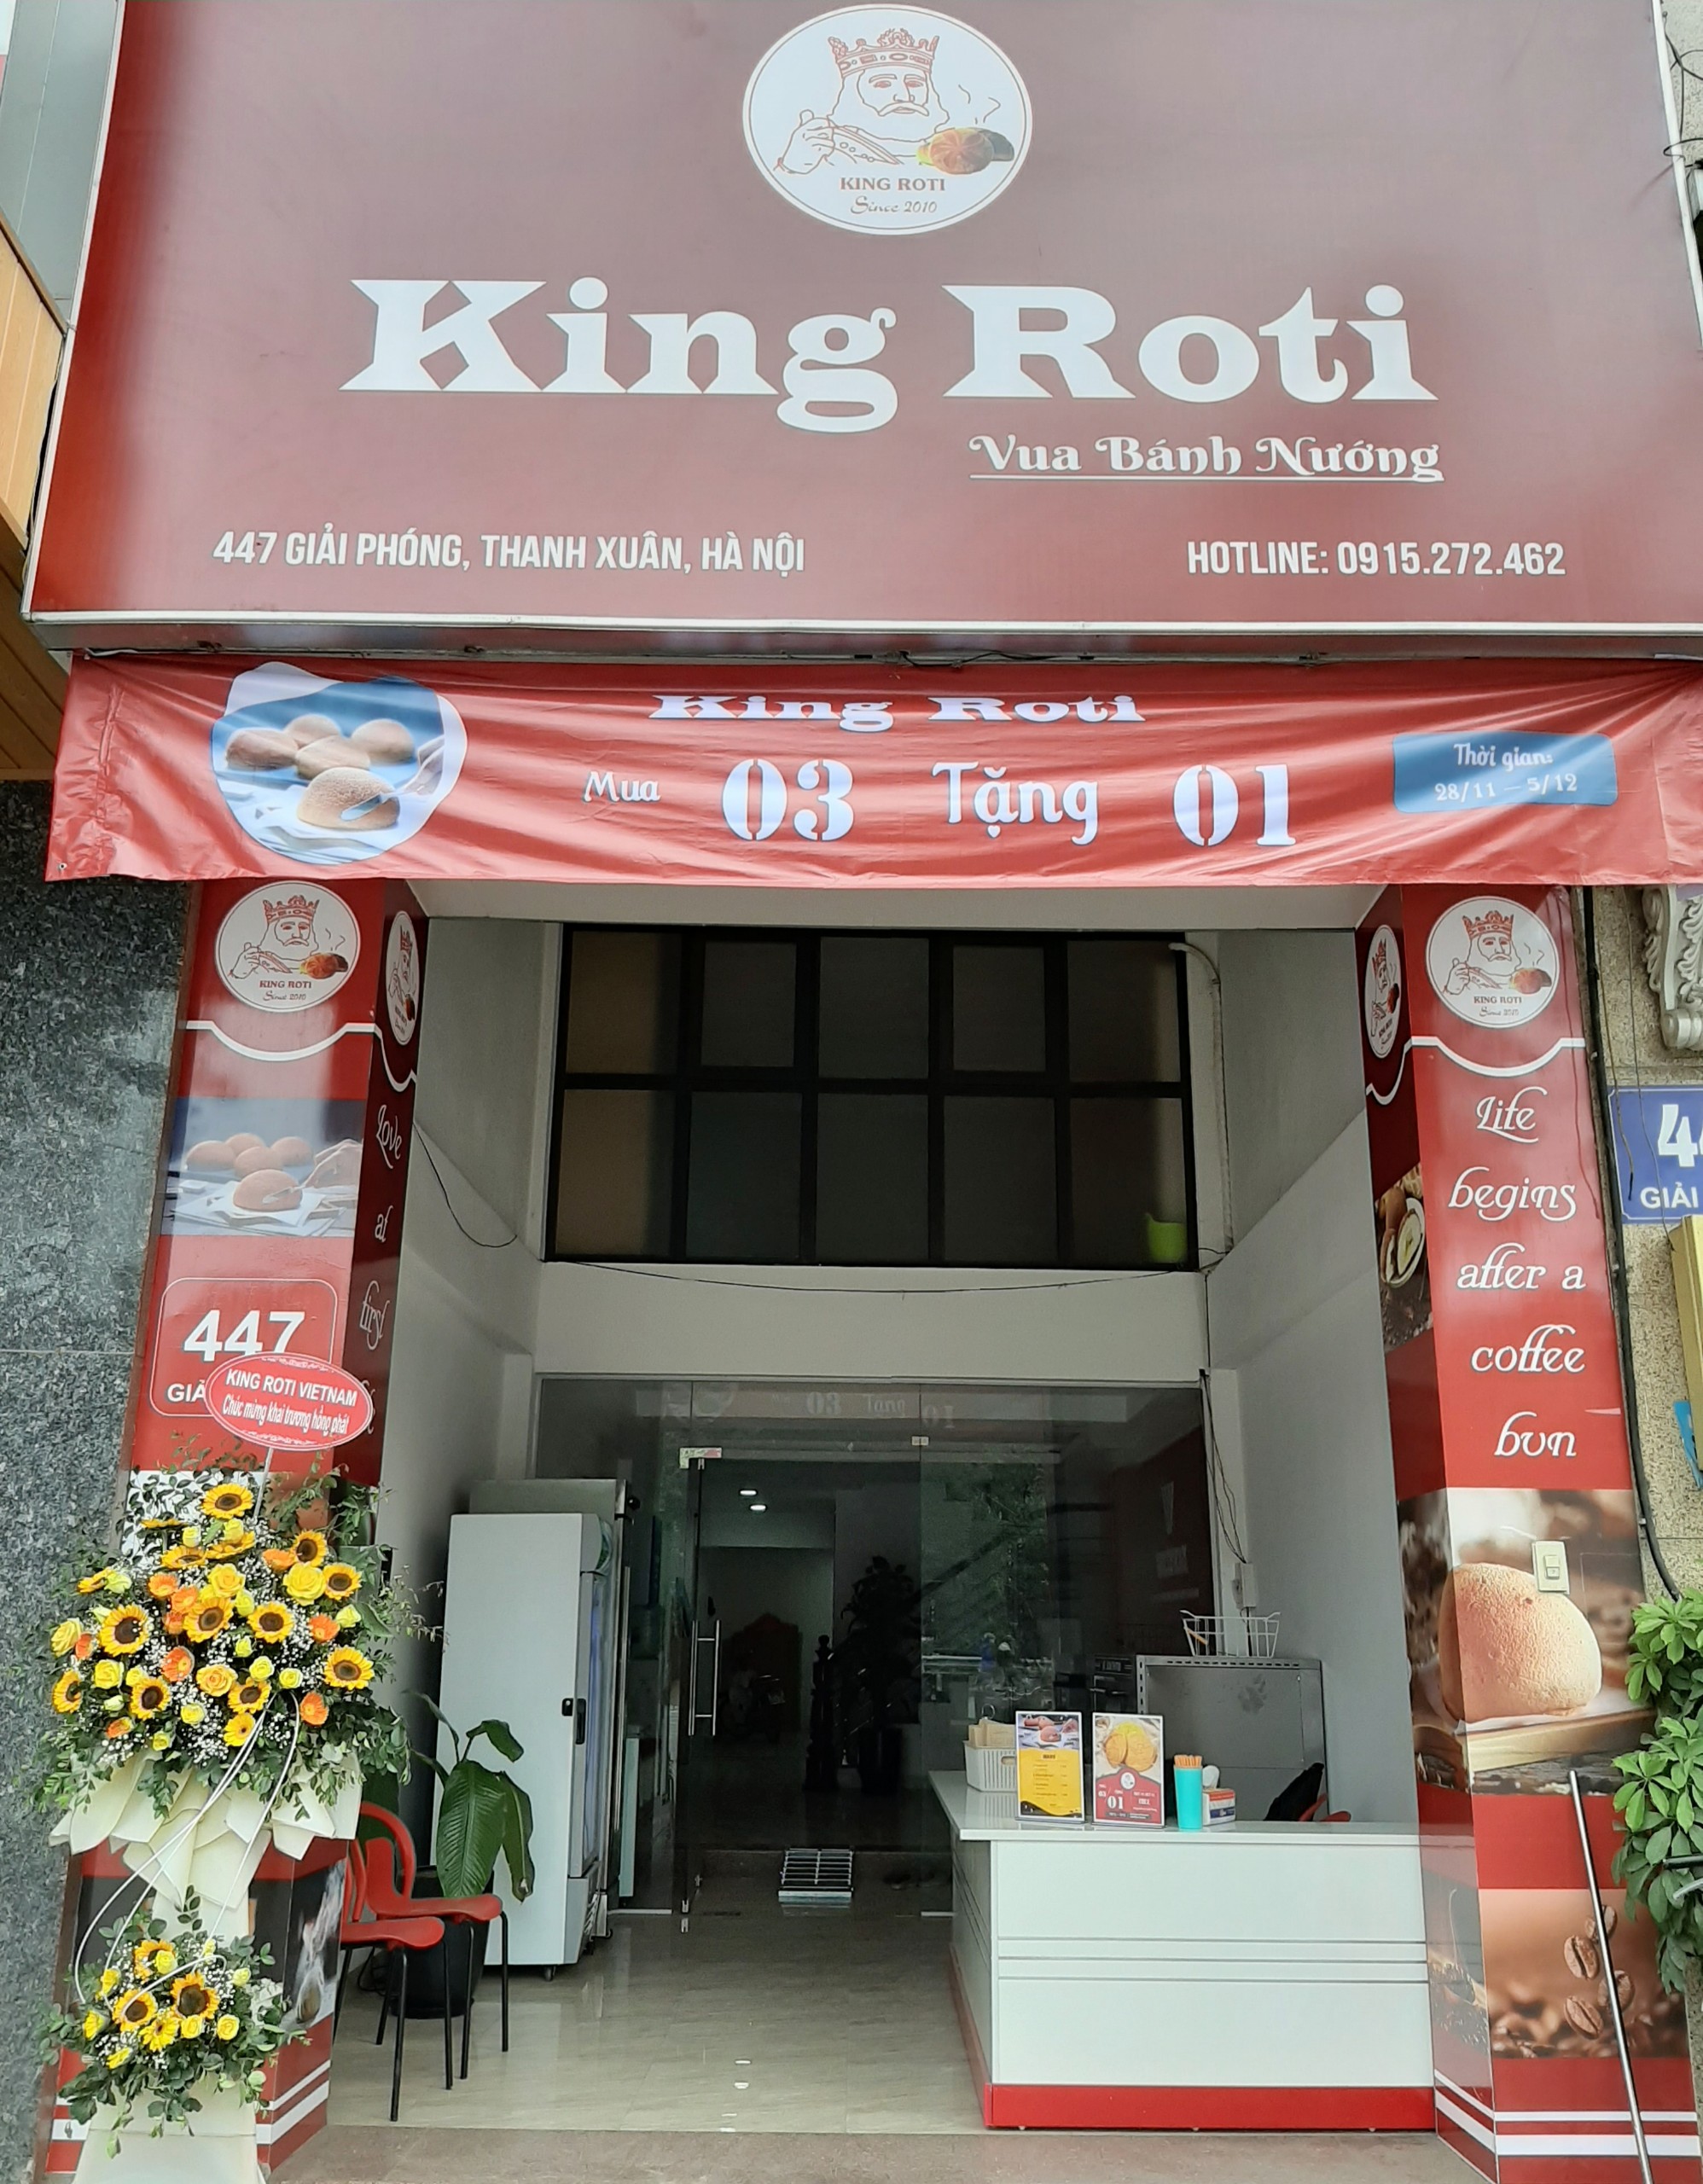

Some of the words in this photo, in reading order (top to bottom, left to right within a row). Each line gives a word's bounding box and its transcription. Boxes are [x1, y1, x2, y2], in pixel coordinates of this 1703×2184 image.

[840, 177, 891, 191] KING
[898, 177, 945, 192] ROTI
[850, 195, 900, 214] Since
[904, 200, 938, 213] 2010
[339, 276, 898, 434] King
[942, 284, 1439, 404] Roti
[968, 434, 1082, 471] Vua
[1096, 435, 1242, 475] Bánh
[1255, 436, 1444, 482] Nướng
[213, 531, 277, 563] 447
[285, 522, 348, 565] GIẢI
[356, 527, 470, 571] PHÓNG,
[480, 534, 586, 568] THANH
[596, 531, 691, 574] XUÂN,
[701, 531, 743, 570] HÀ
[752, 531, 805, 578] NỘI
[1187, 541, 1329, 575] HOTLINE:
[1337, 543, 1566, 576] 0915.272.462
[648, 695, 894, 732] King
[928, 695, 1147, 723] Roti
[1453, 742, 1497, 767] Thời
[583, 770, 661, 803] Mua
[722, 758, 855, 842] 03
[932, 761, 1099, 845] Tặng
[1172, 764, 1297, 846] 01
[1434, 781, 1497, 803] 28/11
[1526, 773, 1578, 795] 5/12
[259, 980, 285, 989] KING
[288, 980, 312, 989] ROTI
[1473, 996, 1497, 1004] KING
[1476, 1087, 1548, 1143] Life
[1658, 1103, 1703, 1168] 4
[375, 1104, 403, 1170] Love
[1448, 1166, 1577, 1221] begins
[1640, 1181, 1700, 1210] GIẢI
[1456, 1242, 1547, 1290] after
[1561, 1264, 1587, 1290] a
[183, 1309, 305, 1362] 447
[359, 1280, 391, 1351] first
[1470, 1324, 1586, 1373] coffee
[166, 1379, 206, 1403] GIẢ
[223, 1393, 245, 1418] Chúc
[266, 1401, 287, 1424] khai
[225, 1368, 261, 1390] KING
[262, 1375, 297, 1397] ROTI
[299, 1381, 357, 1407] VIETNAM
[1494, 1411, 1577, 1457] bun
[1107, 1795, 1124, 1809] 01
